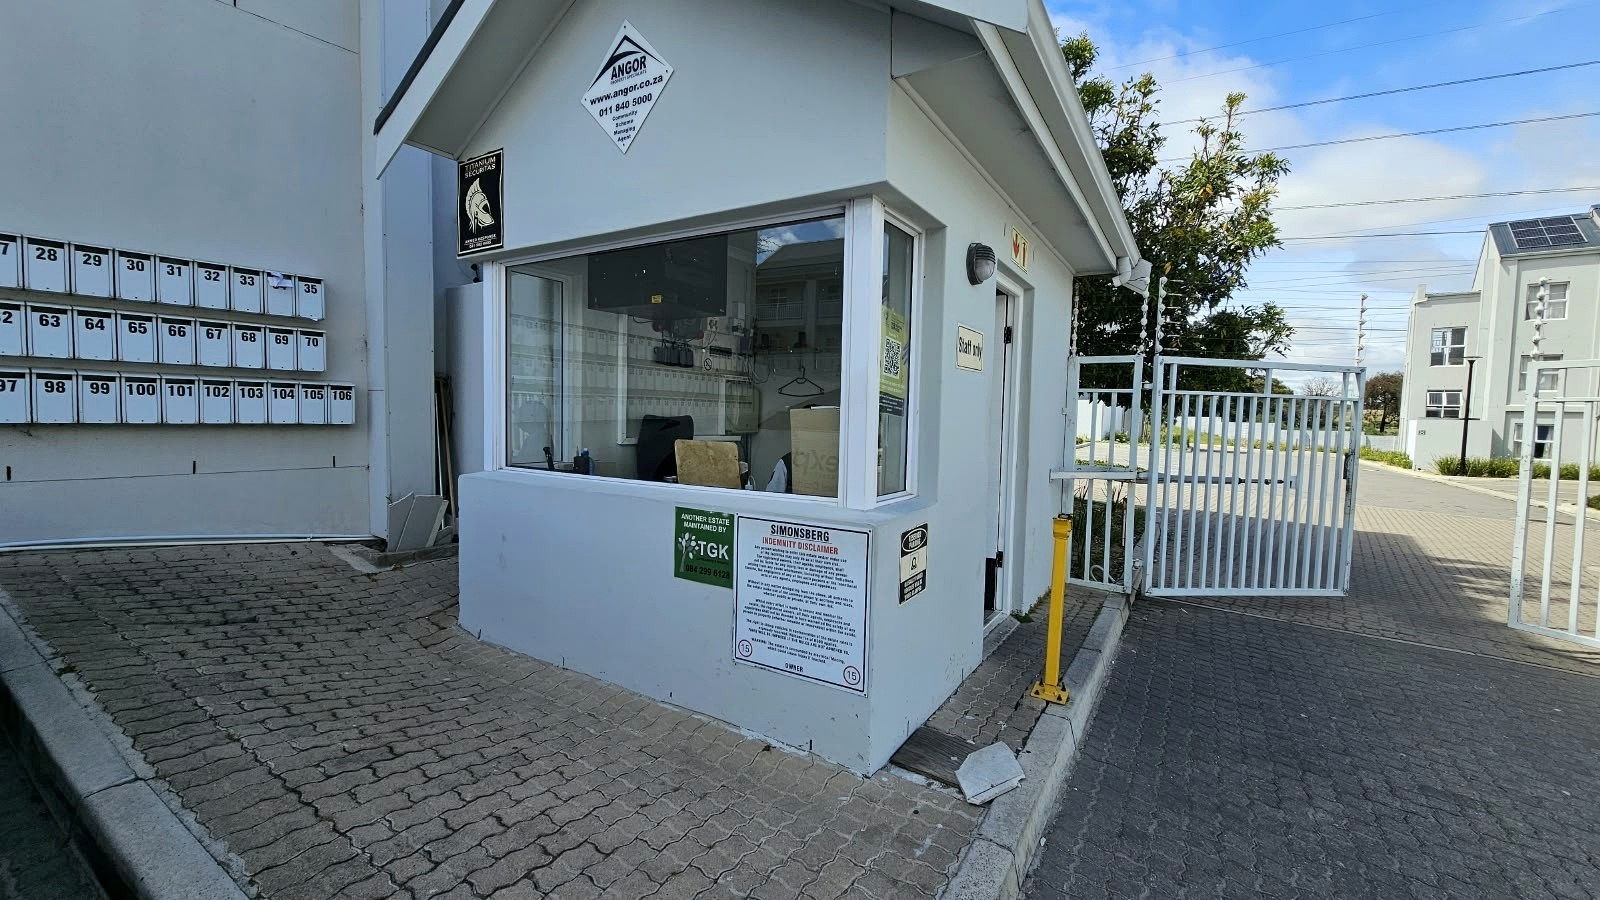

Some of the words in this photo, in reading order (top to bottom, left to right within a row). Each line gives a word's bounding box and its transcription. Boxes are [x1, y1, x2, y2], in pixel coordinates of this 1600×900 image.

[611, 56, 647, 80] ANGOR
[590, 75, 663, 105] www.angor.co.za
[599, 106, 613, 117] 011
[615, 101, 629, 112] 840
[632, 93, 652, 107] 5000
[465, 156, 496, 171] TITANIUM
[465, 164, 496, 178] SECURITAS
[36, 247, 58, 261] 28
[83, 254, 101, 266] 29
[127, 259, 144, 271] 30
[167, 264, 182, 277] 31
[204, 270, 220, 281] 32
[240, 275, 254, 286] 33
[304, 284, 317, 294] 35
[2, 311, 12, 324] 2
[39, 314, 60, 327] 63
[85, 318, 105, 330] 64
[128, 322, 147, 334] 65
[168, 325, 186, 337] 66
[206, 328, 222, 339] 67
[242, 332, 256, 342] 68
[275, 335, 288, 345] 69
[305, 337, 318, 347] 70
[958, 337, 972, 354] Staff
[973, 343, 983, 360] only
[45, 381, 65, 393] 98
[90, 382, 109, 394] 99
[127, 384, 156, 397] 100
[168, 385, 194, 397] 101
[205, 386, 230, 398] 102
[240, 387, 263, 399] 103
[272, 389, 295, 400] 104
[303, 389, 324, 400] 105
[332, 390, 352, 401] 106
[681, 513, 707, 522] ANOTHER
[708, 517, 730, 526] ESTATE
[684, 521, 717, 532] MAINTAINED
[770, 524, 830, 542] SIMONSBERG
[698, 540, 729, 560] TGK
[762, 537, 797, 549] INDEMNITY
[798, 540, 839, 555] DISCLAIMER
[741, 643, 750, 653] 15
[785, 662, 804, 673] OWNER
[847, 670, 857, 681] 15
